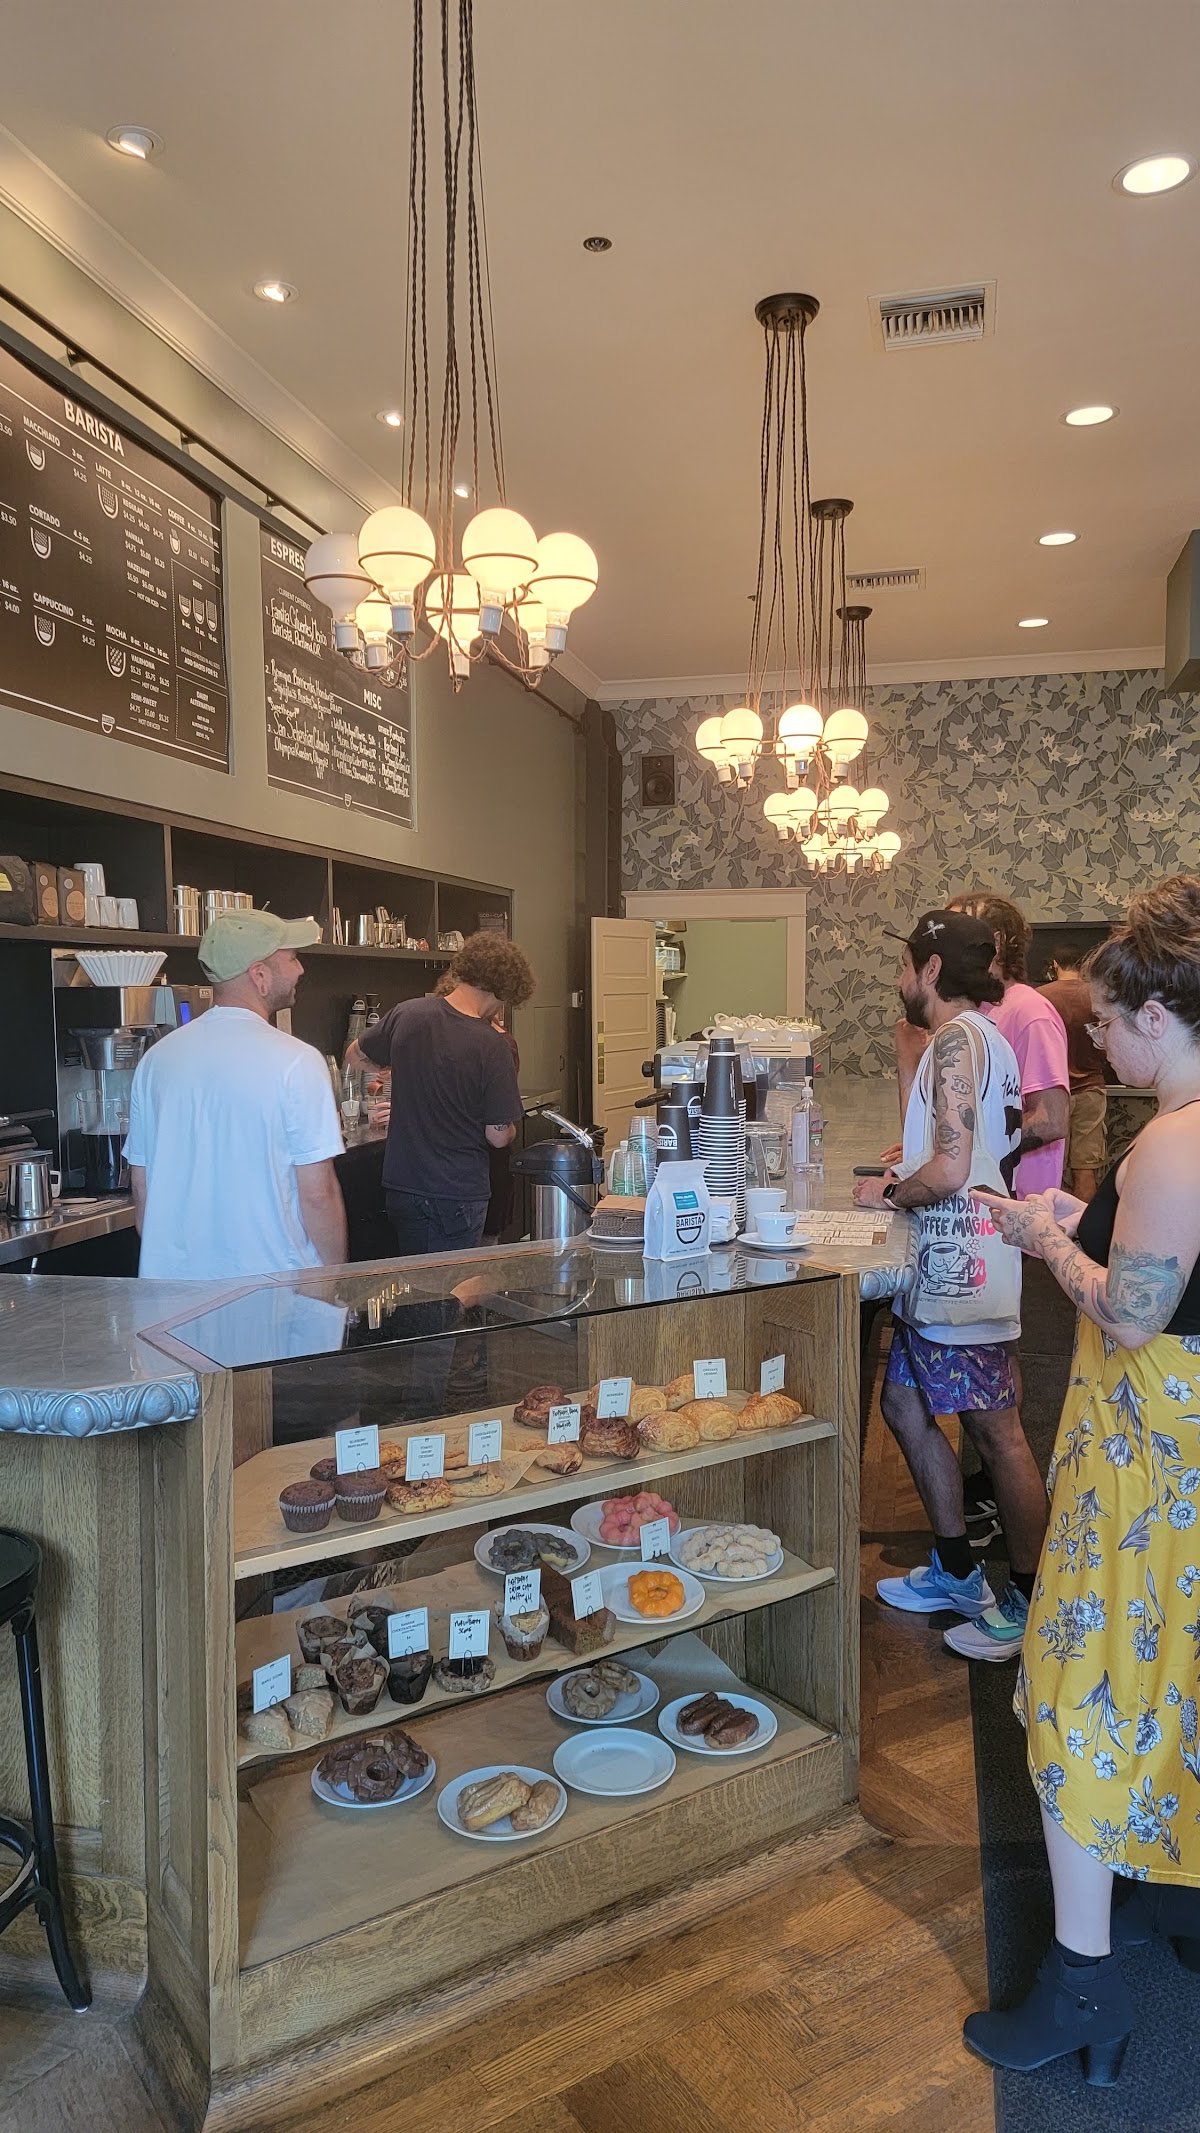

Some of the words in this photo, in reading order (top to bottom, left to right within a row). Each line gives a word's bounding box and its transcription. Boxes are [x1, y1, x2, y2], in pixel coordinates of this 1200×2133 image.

[0, 422, 13, 437] 3.50
[23, 415, 61, 447] MACCHIATO
[63, 398, 125, 457] BARISTA
[71, 448, 76, 457] 3
[73, 468, 88, 483] $4.25
[95, 462, 112, 480] LATTE
[28, 504, 61, 528] CORTADO
[122, 498, 144, 517] REGULAR
[167, 508, 185, 526] COFFEE
[124, 529, 144, 546] VANILLA
[78, 551, 93, 565] $4.25
[271, 537, 305, 573] ESPRES
[126, 560, 150, 579] HAZELNUT
[4, 601, 20, 614] $4.00
[33, 592, 74, 617] CAPPUCCINO
[105, 623, 127, 640] MOCHA
[130, 692, 157, 708] SEMI-SWEET
[363, 688, 382, 711] MISC
[676, 1216, 702, 1229] BARISTA
[951, 1217, 997, 1238] MAGIC
